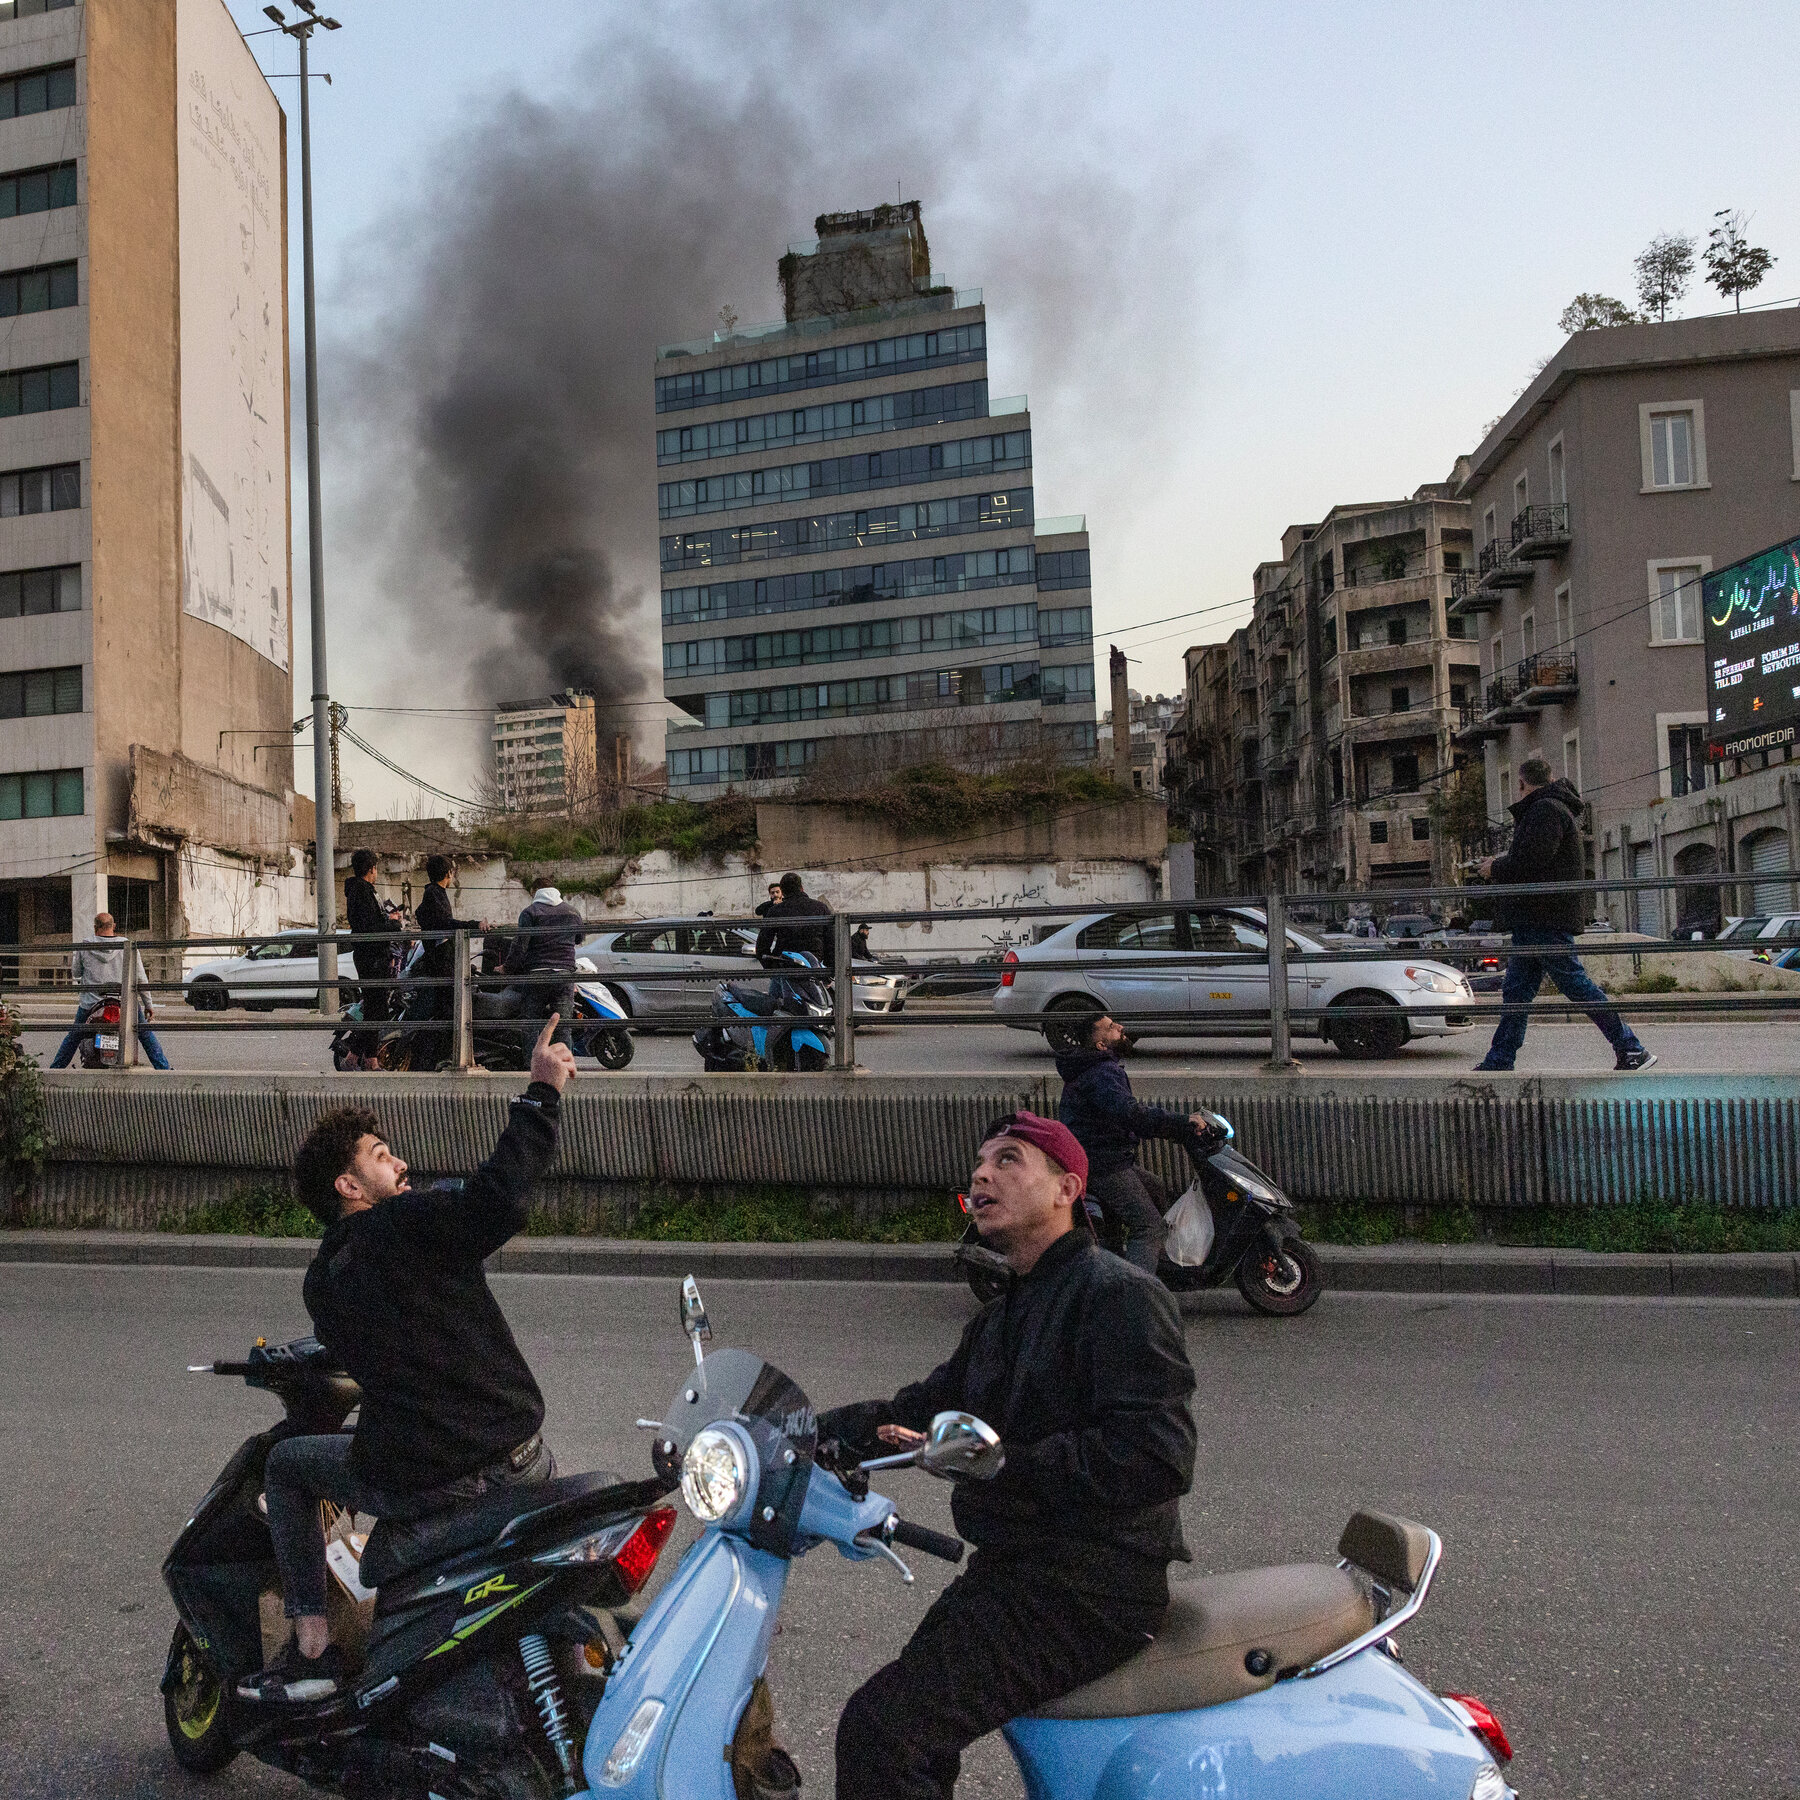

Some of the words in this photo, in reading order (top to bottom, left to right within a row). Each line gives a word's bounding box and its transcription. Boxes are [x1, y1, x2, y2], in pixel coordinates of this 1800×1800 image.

[1711, 577, 1751, 627] زمان
[1749, 564, 1787, 618] ليالي
[1730, 624, 1751, 640] LAYALI
[1752, 615, 1775, 632] ZAMAN
[1713, 657, 1727, 669] FROM
[1761, 646, 1788, 664] FORUM
[1788, 642, 1800, 655] DE
[1722, 657, 1756, 677] FEBRUARY
[1714, 678, 1731, 690] TILL
[1730, 673, 1743, 686] EID
[1725, 727, 1796, 756] PROMOMEDIA
[1208, 991, 1232, 1000] TAXI
[464, 1573, 519, 1605] GR
